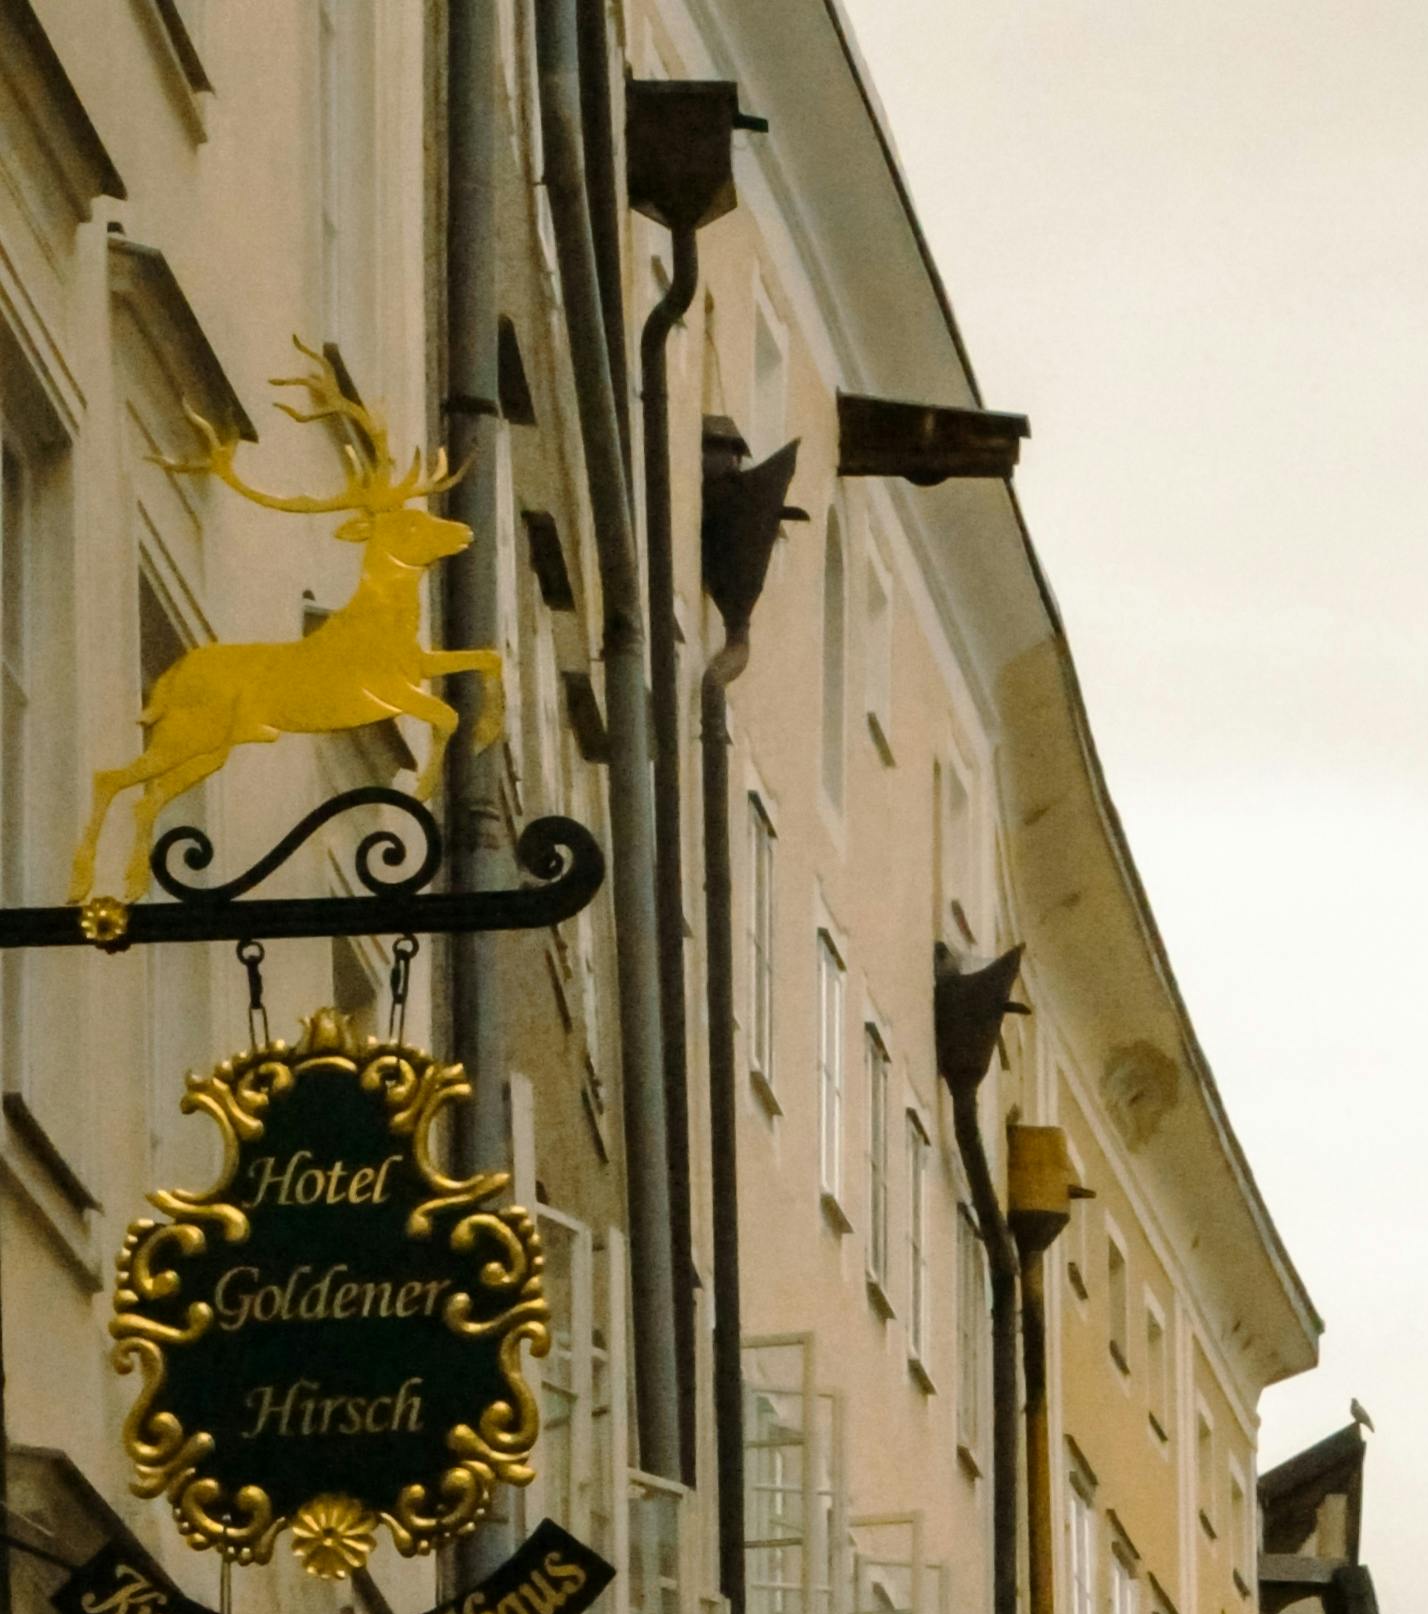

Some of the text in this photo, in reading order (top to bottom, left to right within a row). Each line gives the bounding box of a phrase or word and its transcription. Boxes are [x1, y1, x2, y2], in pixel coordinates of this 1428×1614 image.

[241, 1152, 402, 1208] Hotel
[214, 1265, 451, 1331] Goldener
[241, 1377, 425, 1440] Hirsch
